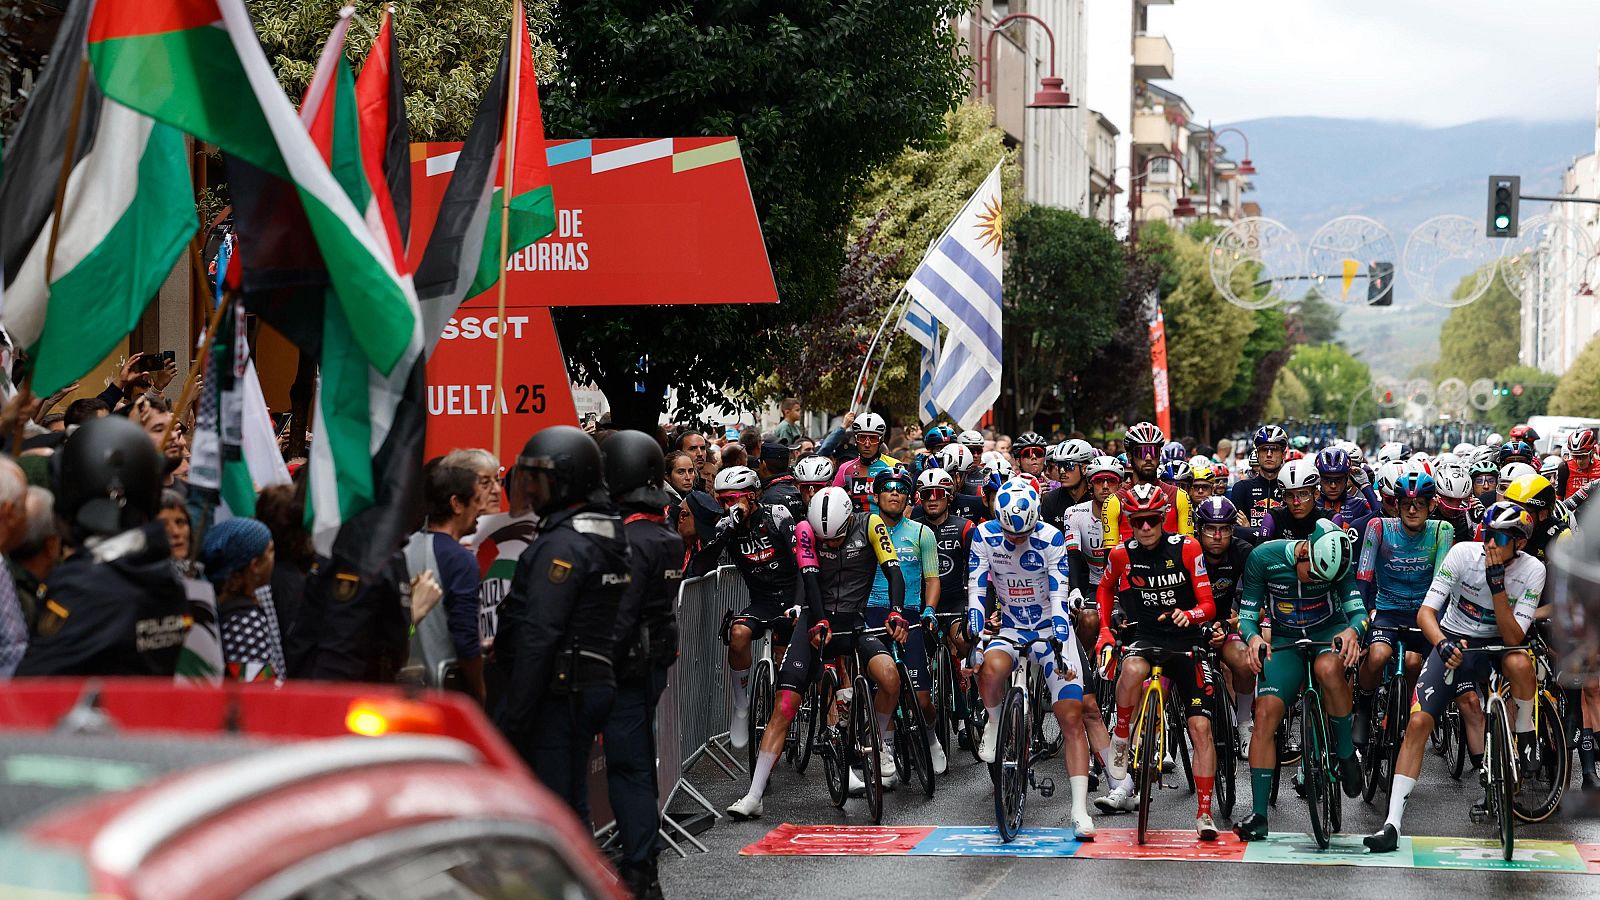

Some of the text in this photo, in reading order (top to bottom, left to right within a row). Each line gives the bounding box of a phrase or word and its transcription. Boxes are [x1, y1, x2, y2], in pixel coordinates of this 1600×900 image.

[559, 209, 584, 238] DE
[515, 384, 547, 415] 25
[740, 536, 773, 555] UAE
[1007, 578, 1034, 588] UAE
[1148, 571, 1187, 588] VISMA
